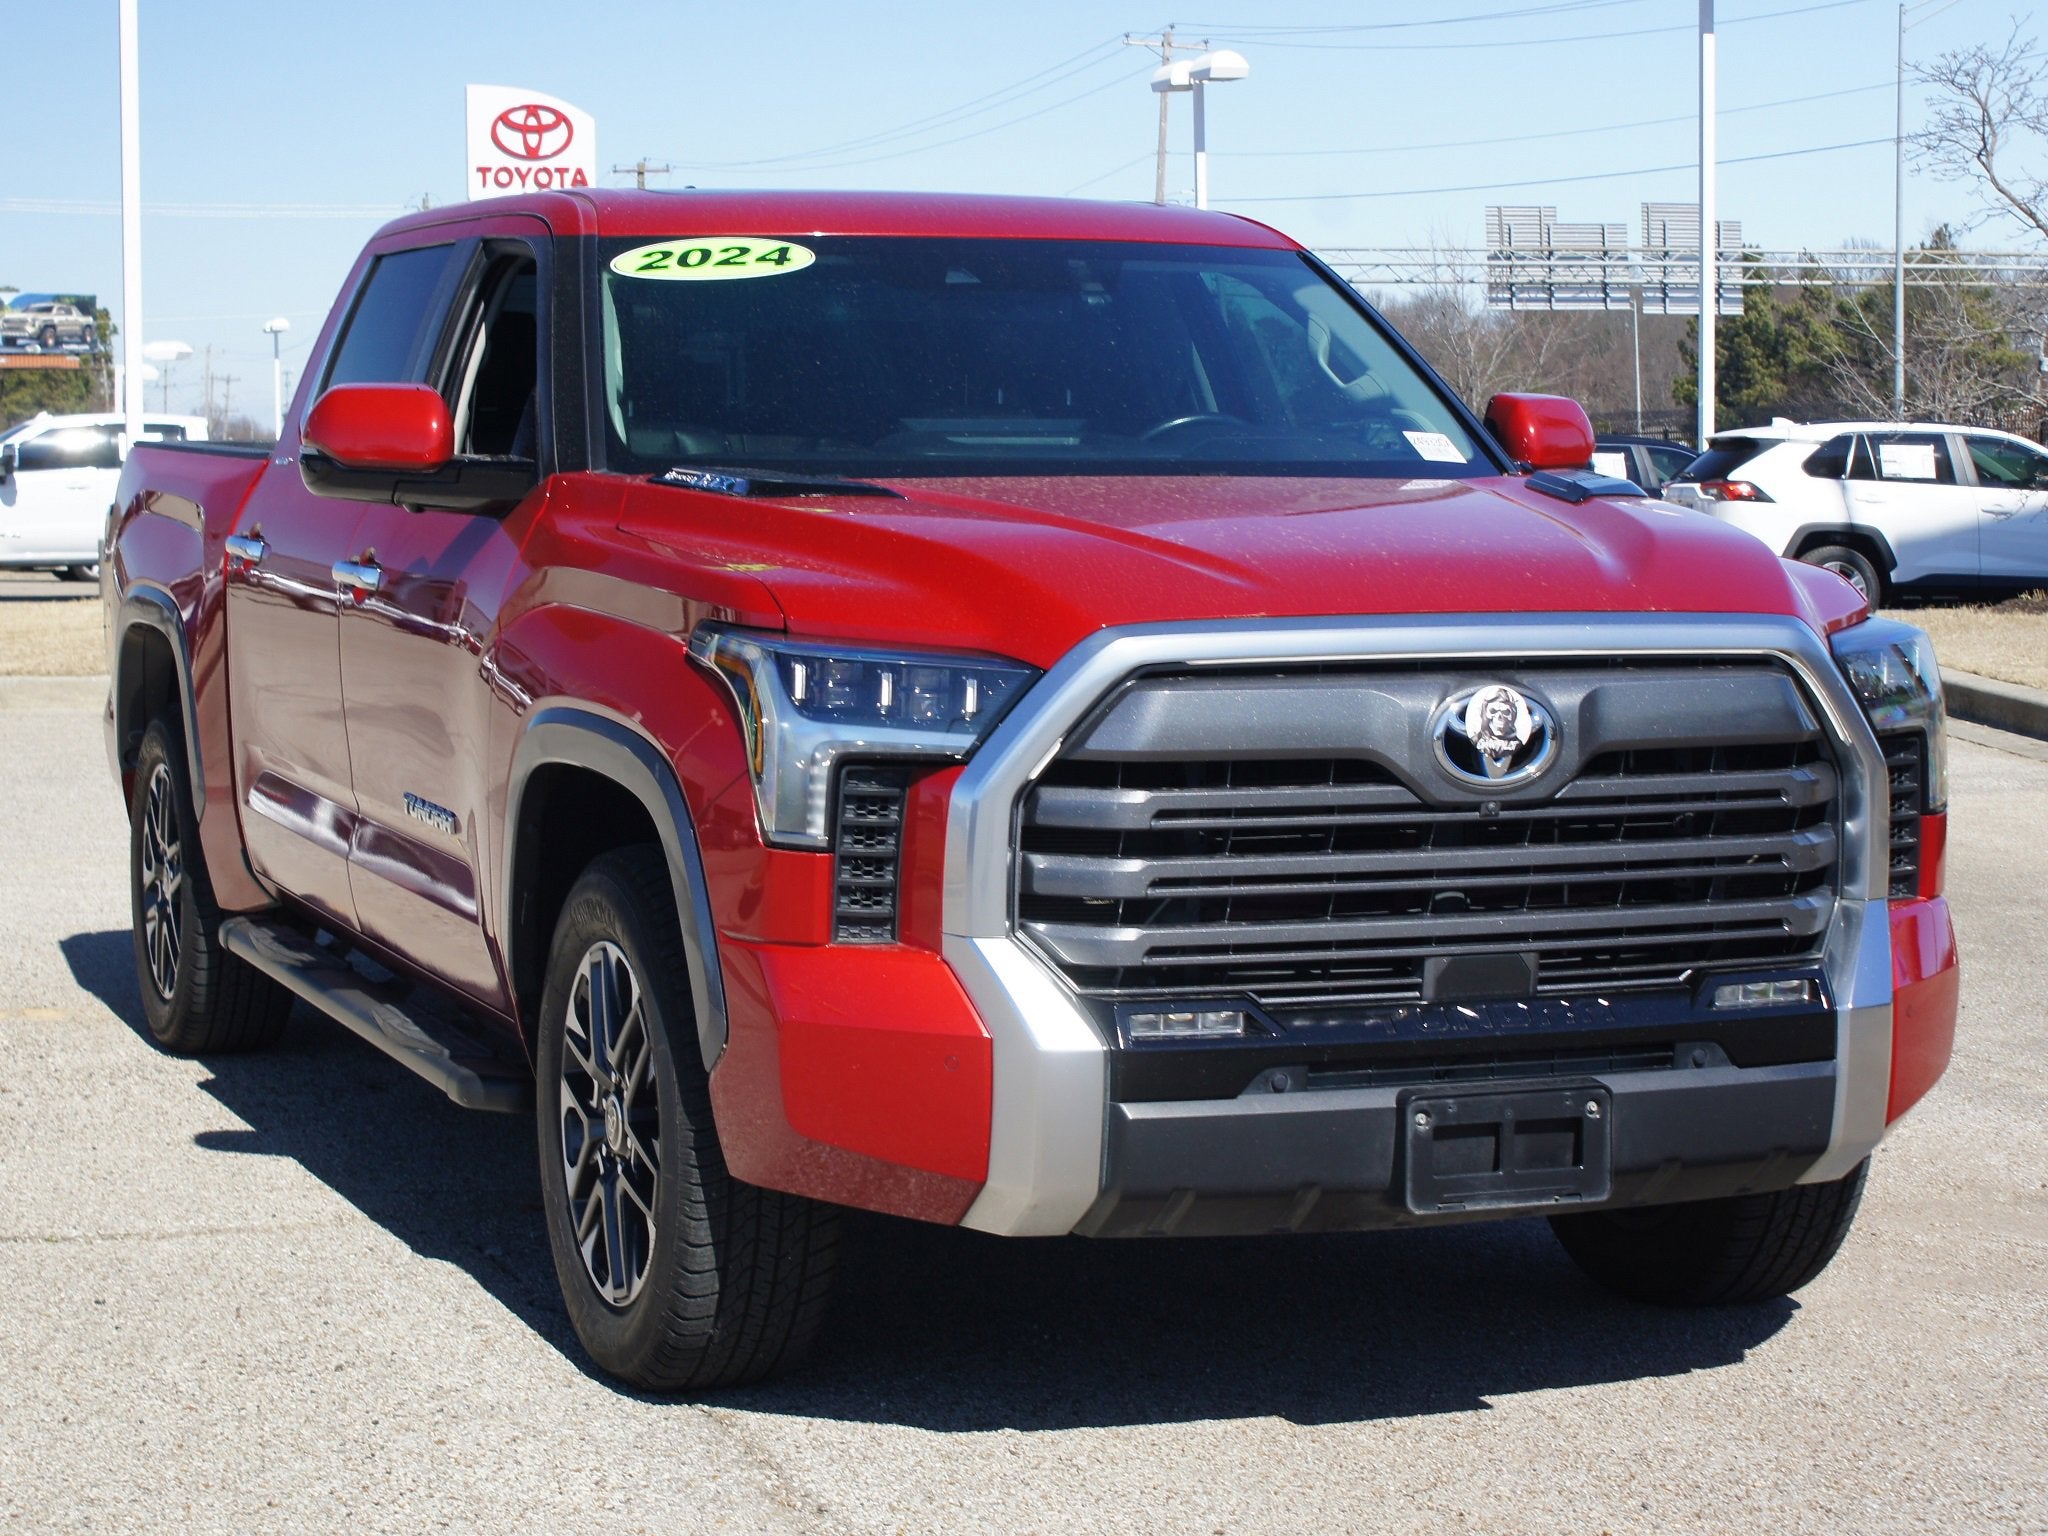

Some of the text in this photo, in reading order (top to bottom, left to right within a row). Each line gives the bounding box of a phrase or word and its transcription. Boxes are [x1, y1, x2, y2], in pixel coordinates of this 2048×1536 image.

[476, 166, 588, 190] TOYOTA
[635, 246, 793, 272] 2024
[403, 791, 457, 835] TUNDRA
[1380, 997, 1617, 1035] TUNDRA
